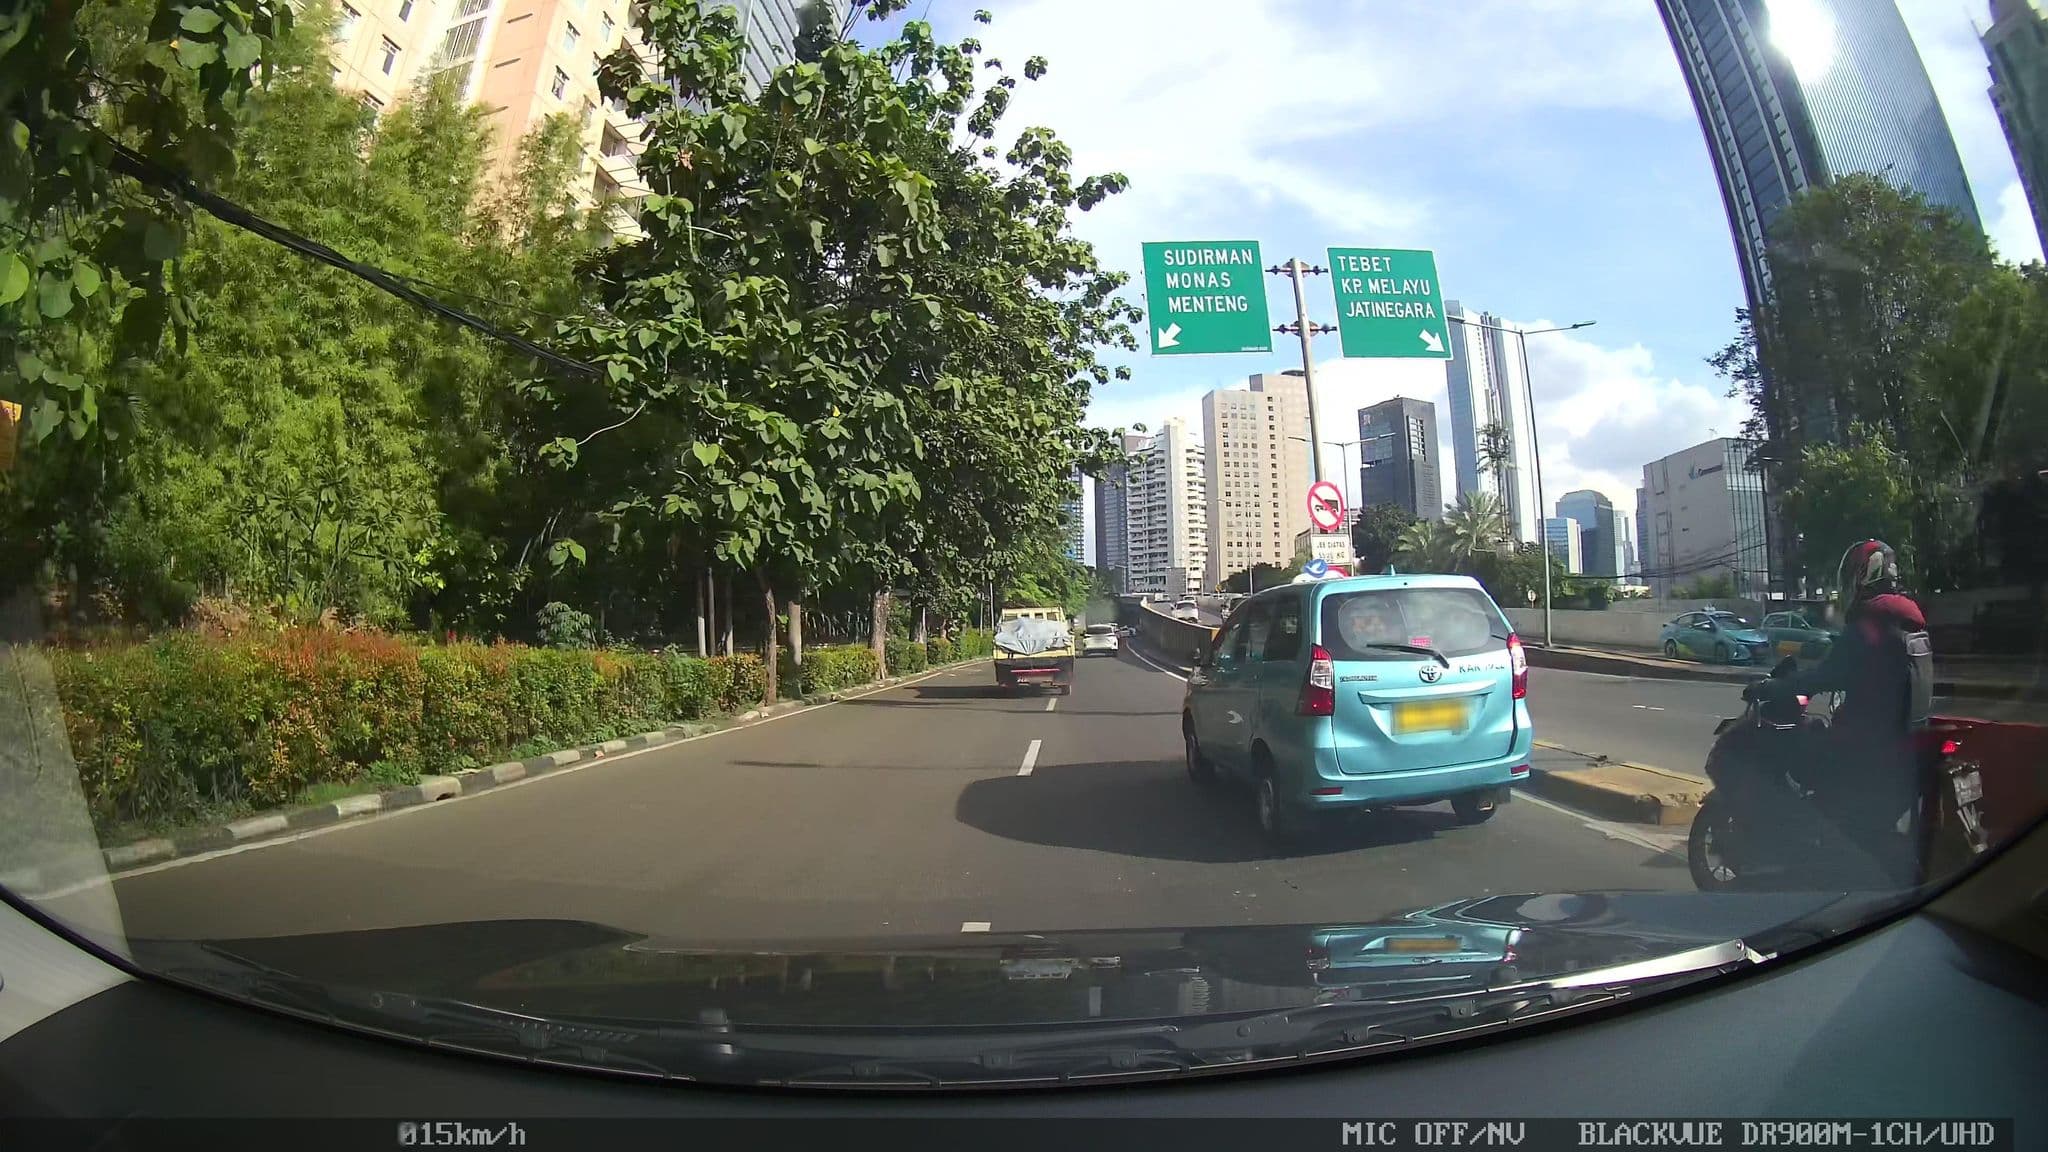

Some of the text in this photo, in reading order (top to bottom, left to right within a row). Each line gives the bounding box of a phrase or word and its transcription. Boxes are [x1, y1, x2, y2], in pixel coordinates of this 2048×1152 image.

[1163, 248, 1253, 266] SUDIRMAN
[1337, 255, 1391, 273] TEBET
[1166, 271, 1231, 289] MONAS
[1368, 279, 1431, 295] MELAYU
[1169, 295, 1248, 313] MENTENG
[1346, 301, 1436, 319] JATINEGARA
